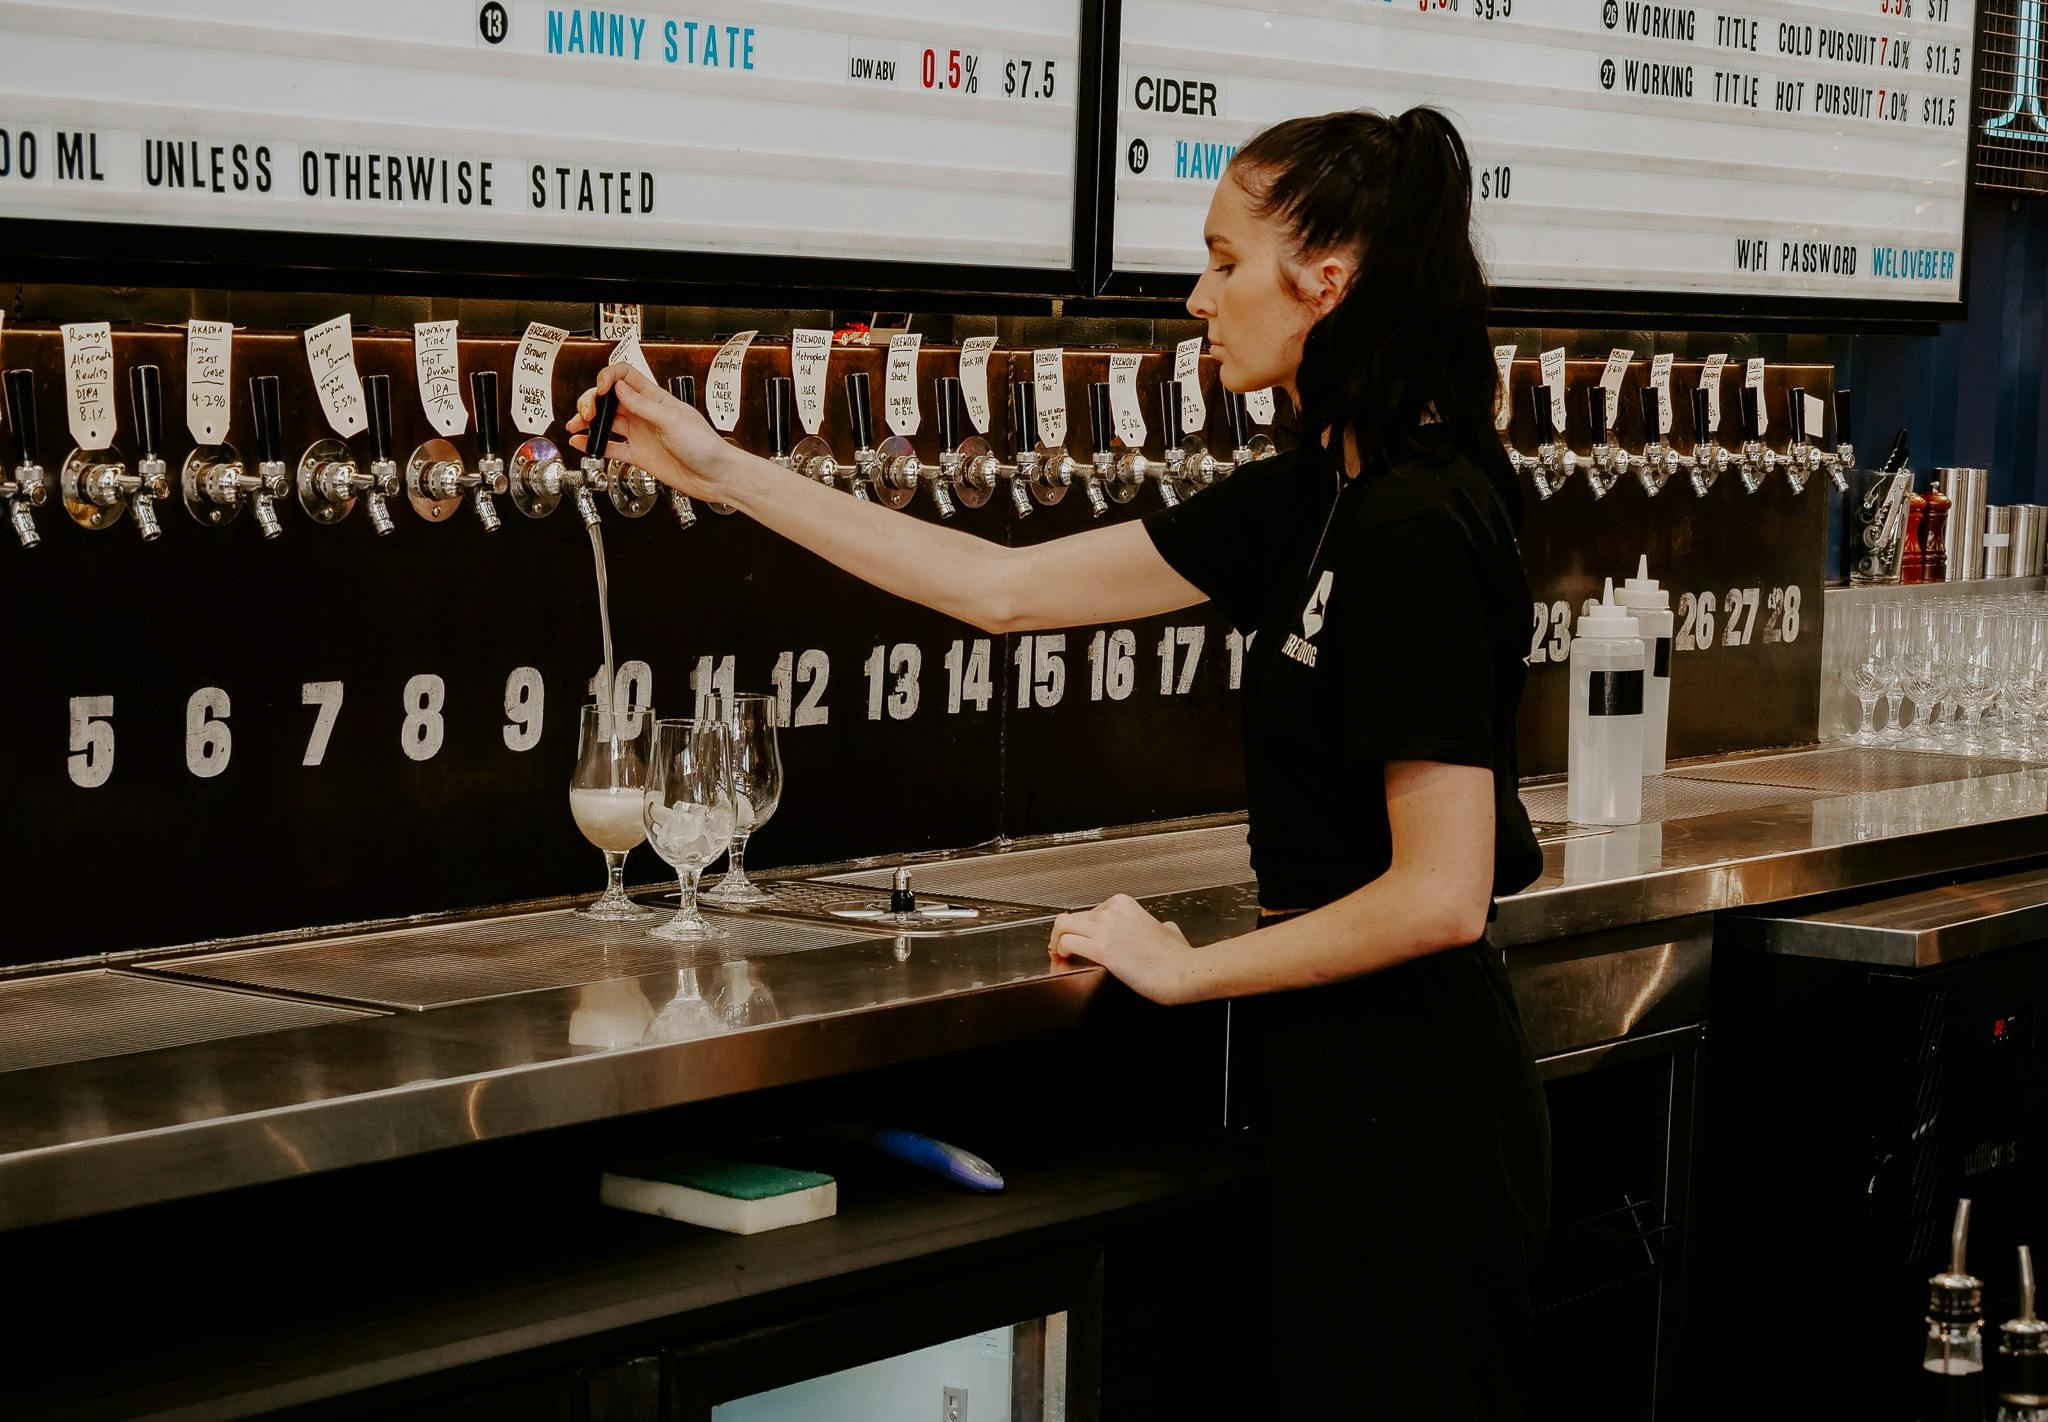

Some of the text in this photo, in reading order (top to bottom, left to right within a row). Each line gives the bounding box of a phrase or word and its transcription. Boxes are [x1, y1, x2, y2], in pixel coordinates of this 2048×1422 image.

[483, 6, 1056, 98] 13 NANNY STATE LOW ABV 0.5% $7.5
[1604, 1, 1961, 76] 26 WORKING TITLE COLD PURSUIT 7.0% $11.5
[1134, 76, 1217, 117] CIDER
[1602, 59, 1956, 127] 27 WORKING TITLE HOT PURSUIT 7.0% $11.5
[57, 131, 104, 181] ML
[145, 139, 272, 193] UNLESS
[302, 150, 493, 207] OTHERWISE
[531, 164, 655, 214] STATED
[1131, 142, 1146, 171] 19
[1481, 166, 1511, 201] $10
[1781, 242, 1857, 276] PASSWORD
[1873, 247, 1956, 280] WELOVEBEER
[69, 328, 107, 343] Range
[524, 343, 548, 360] Brown
[795, 333, 826, 346] BREWDOG
[520, 358, 544, 375] Snake
[76, 387, 98, 400] DIPA
[432, 384, 449, 397] IPA
[519, 384, 546, 400] GINGER
[67, 694, 114, 788] 5
[185, 686, 232, 778] 6
[301, 680, 344, 766] 7
[401, 673, 445, 761] 8
[503, 666, 545, 752] 9
[588, 660, 653, 742] 10
[770, 649, 830, 728] 12
[864, 643, 922, 720] 13
[944, 639, 993, 712] 14
[1014, 633, 1066, 709] 15
[1087, 628, 1136, 701] 16
[1157, 625, 1206, 695] 17
[1225, 627, 1257, 689] 1
[1529, 600, 1571, 663] 23
[1675, 591, 1716, 651] 26
[1722, 588, 1760, 647] 27
[1762, 585, 1801, 645] 28
